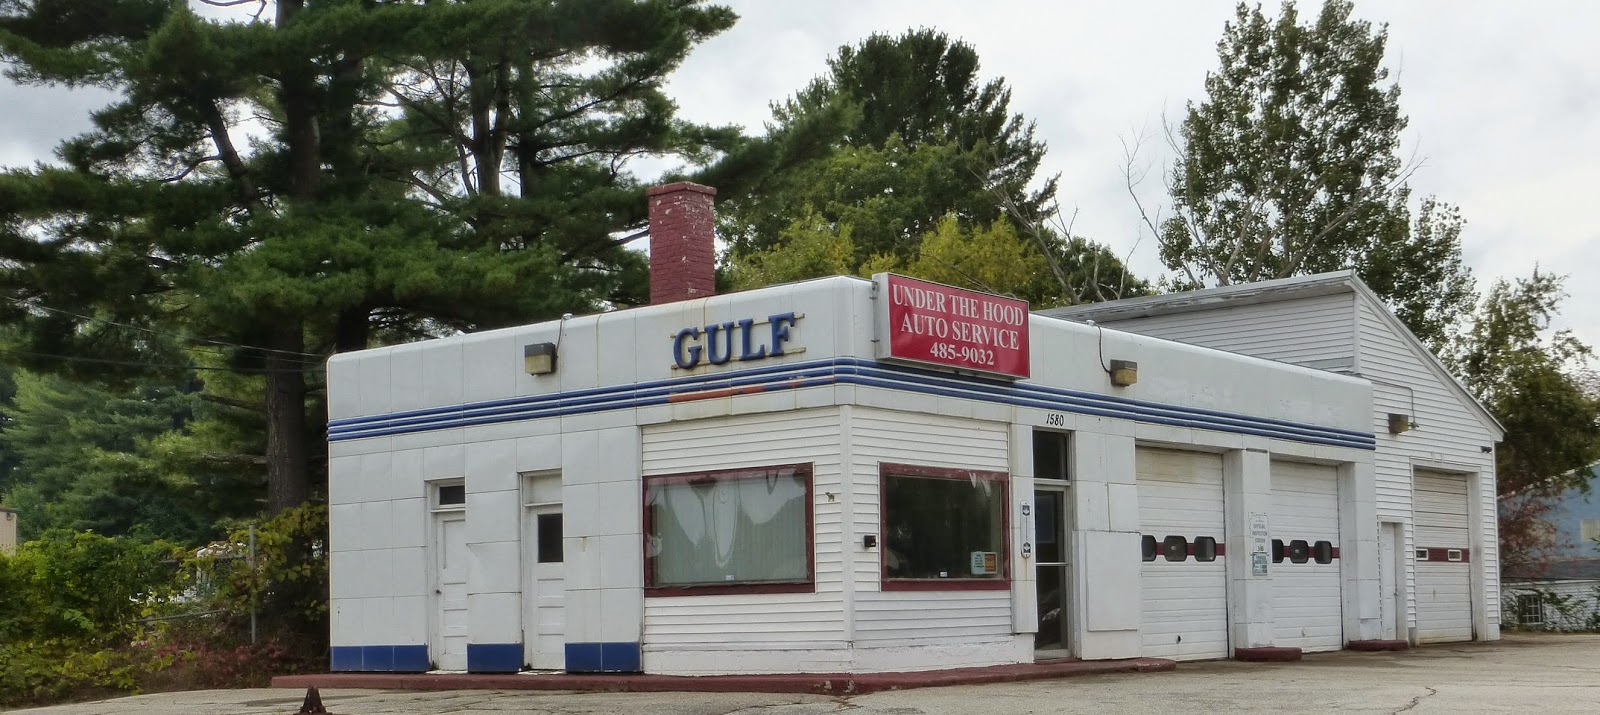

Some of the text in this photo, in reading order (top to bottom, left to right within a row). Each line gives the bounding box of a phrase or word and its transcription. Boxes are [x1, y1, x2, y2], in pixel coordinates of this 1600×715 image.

[892, 283, 1024, 327] UNDER THE HOOD
[673, 311, 795, 370] GULF
[901, 312, 1019, 350] AUTO SERVICE
[930, 341, 994, 366] 485-9032
[1046, 413, 1064, 426] 1580
